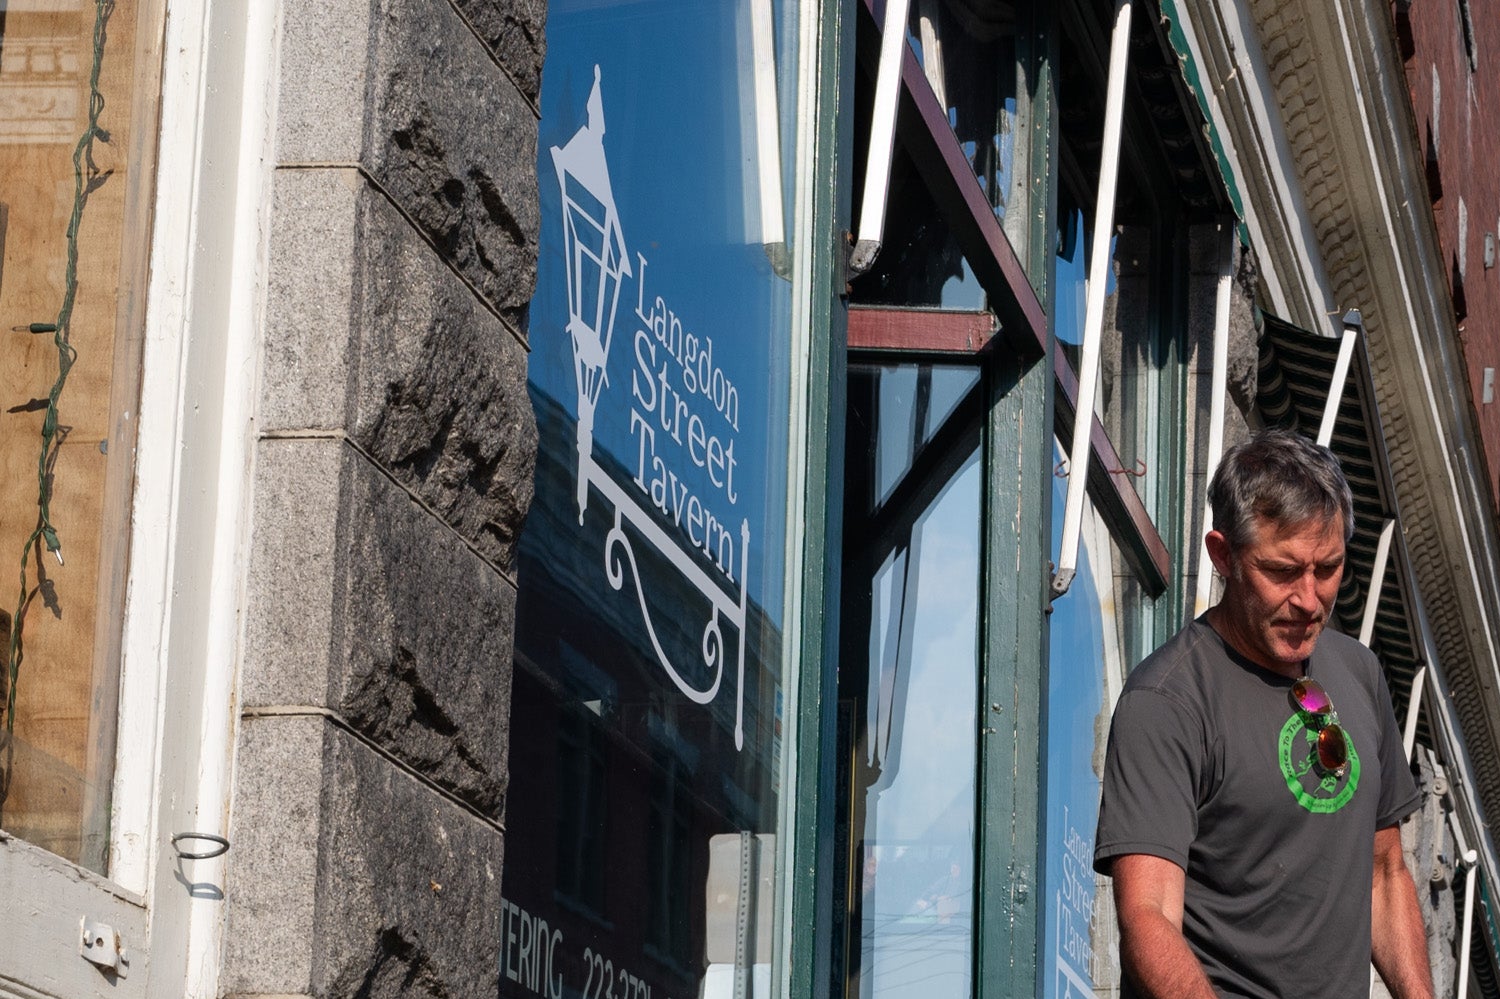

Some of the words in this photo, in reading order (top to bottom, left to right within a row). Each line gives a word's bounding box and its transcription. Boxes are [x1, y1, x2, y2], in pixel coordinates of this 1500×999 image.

[635, 251, 740, 433] Langdon
[632, 329, 738, 505] Street
[630, 406, 735, 584] Tavern
[1286, 719, 1301, 734] The
[1063, 805, 1098, 884] Langd
[1062, 903, 1101, 989] Tavern
